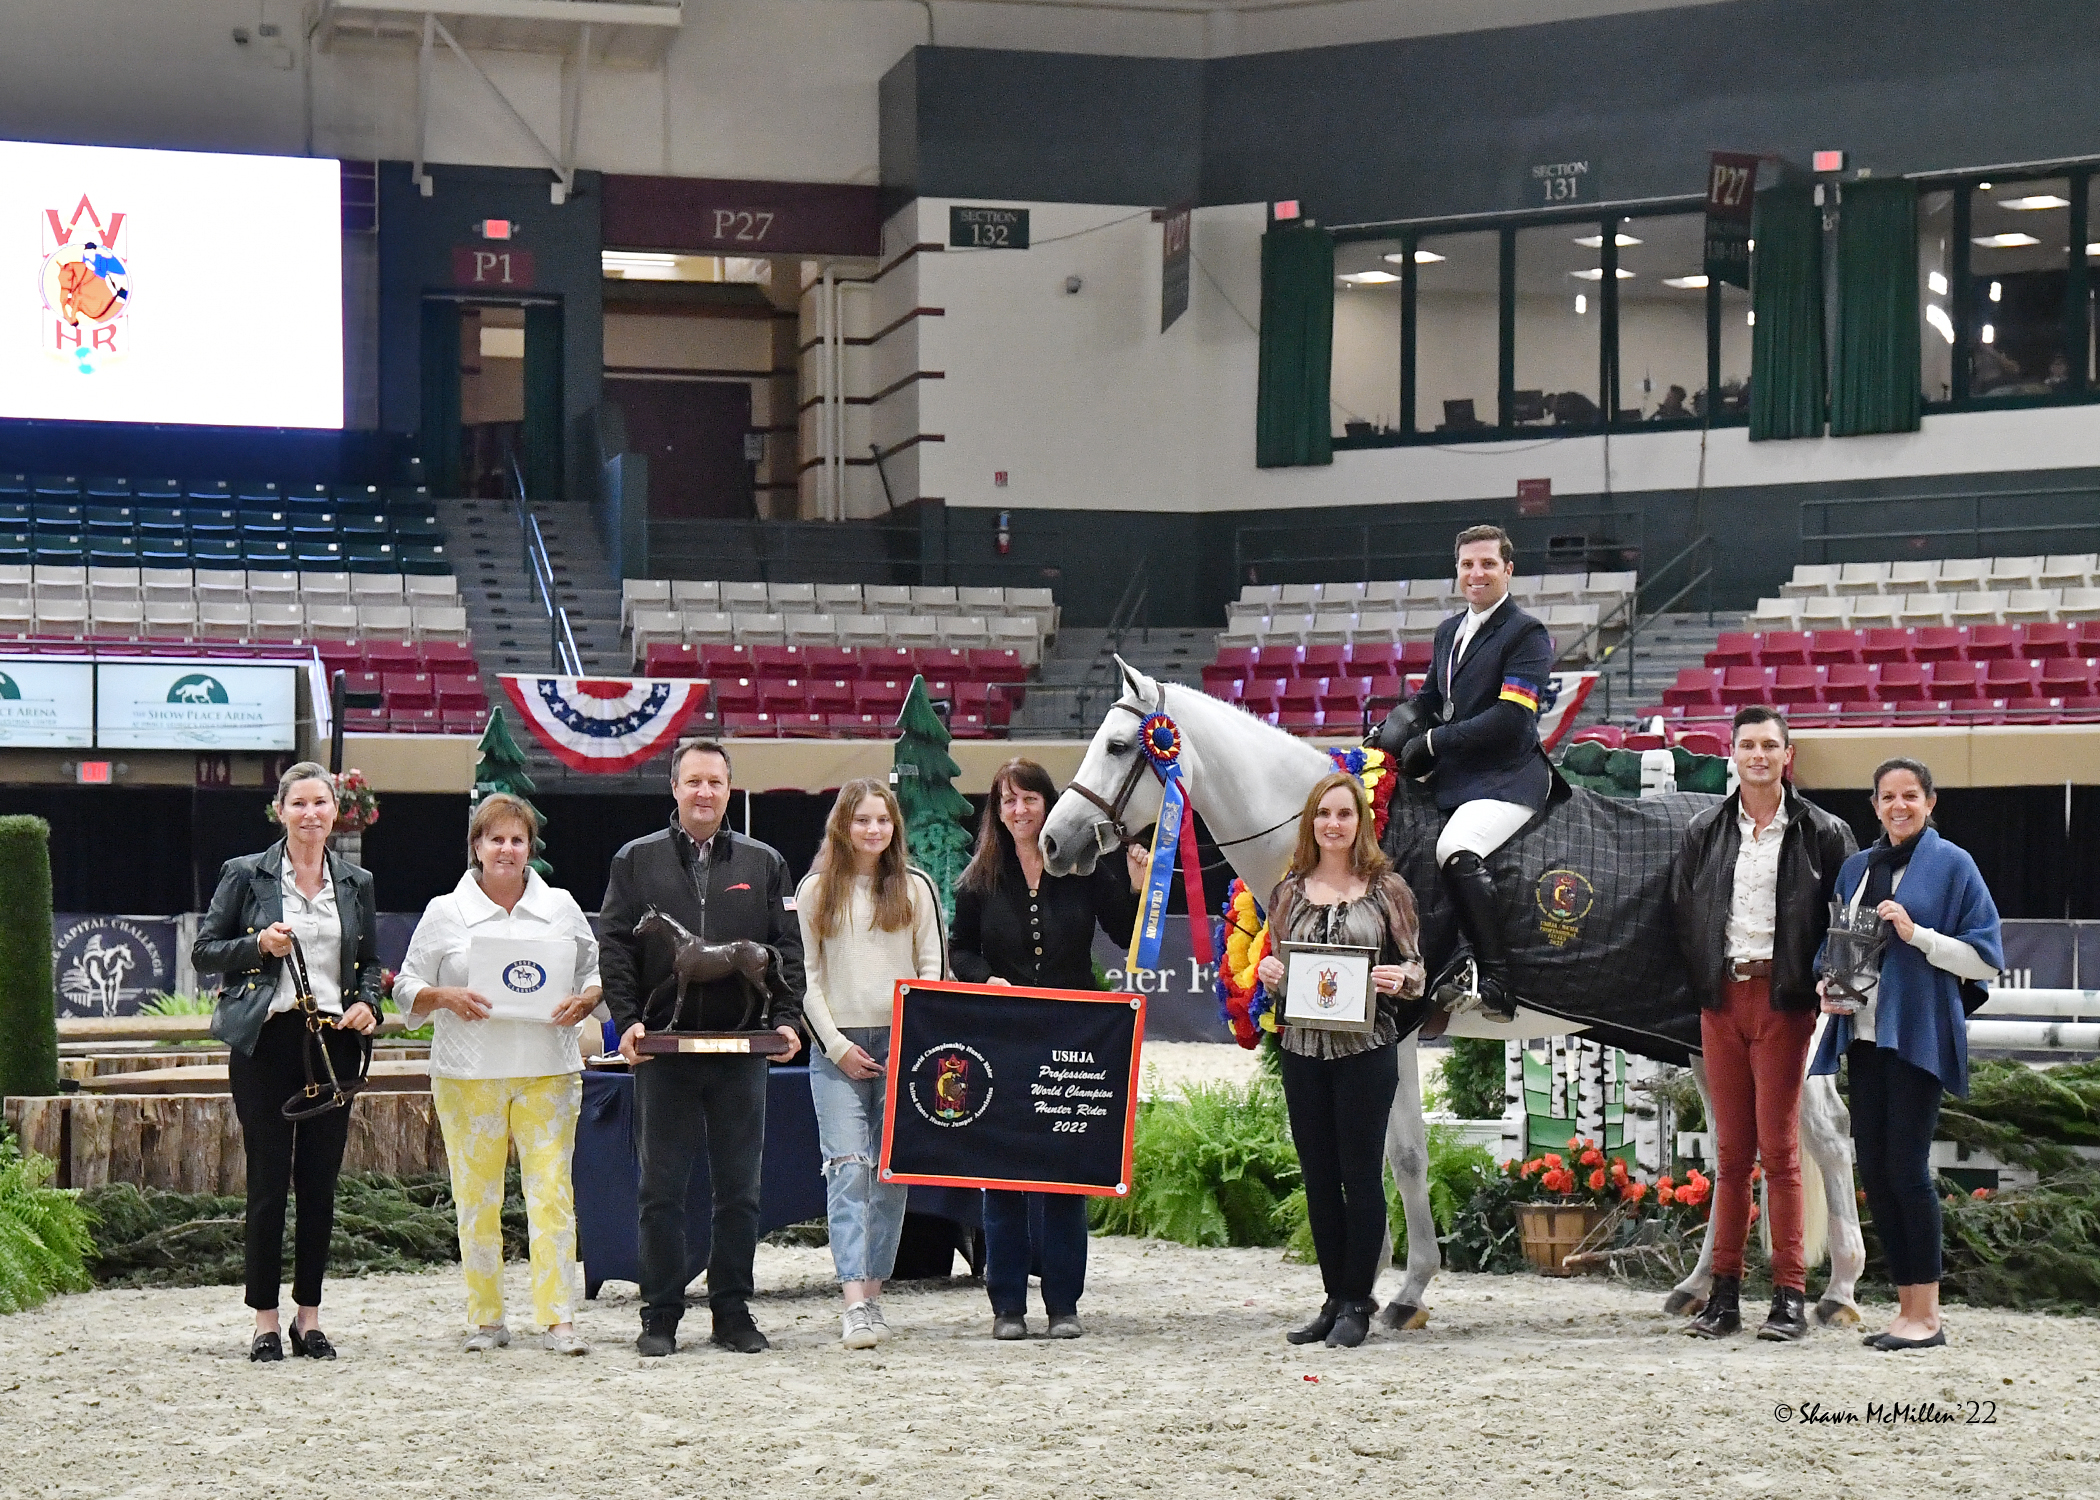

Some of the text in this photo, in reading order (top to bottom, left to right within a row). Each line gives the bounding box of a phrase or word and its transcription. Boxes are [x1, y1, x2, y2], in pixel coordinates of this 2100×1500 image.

[1532, 161, 1589, 178] SECTION
[1543, 177, 1577, 200] 131
[1711, 165, 1749, 206] P27
[712, 208, 775, 240] P27
[971, 224, 1010, 245] 132
[473, 251, 514, 283] P1
[17, 708, 56, 717] ARENA
[148, 710, 184, 719] SHOW
[187, 710, 221, 720] PLACE
[224, 710, 263, 720] ARENA
[1145, 890, 1163, 939] CHAMPION
[57, 918, 108, 949] CAPITAL
[110, 919, 164, 977] CHALLENGE
[1105, 957, 1176, 993] eler
[911, 1042, 994, 1079] World Championship Hunter Rider
[1052, 1050, 1095, 1063] USHJA
[1039, 1065, 1107, 1081] Professional
[1031, 1083, 1114, 1100] World Champion
[909, 1082, 994, 1128] United States Hunter Jumper Association
[1034, 1101, 1108, 1116] Hunter Rider
[1052, 1121, 1088, 1133] 2022
